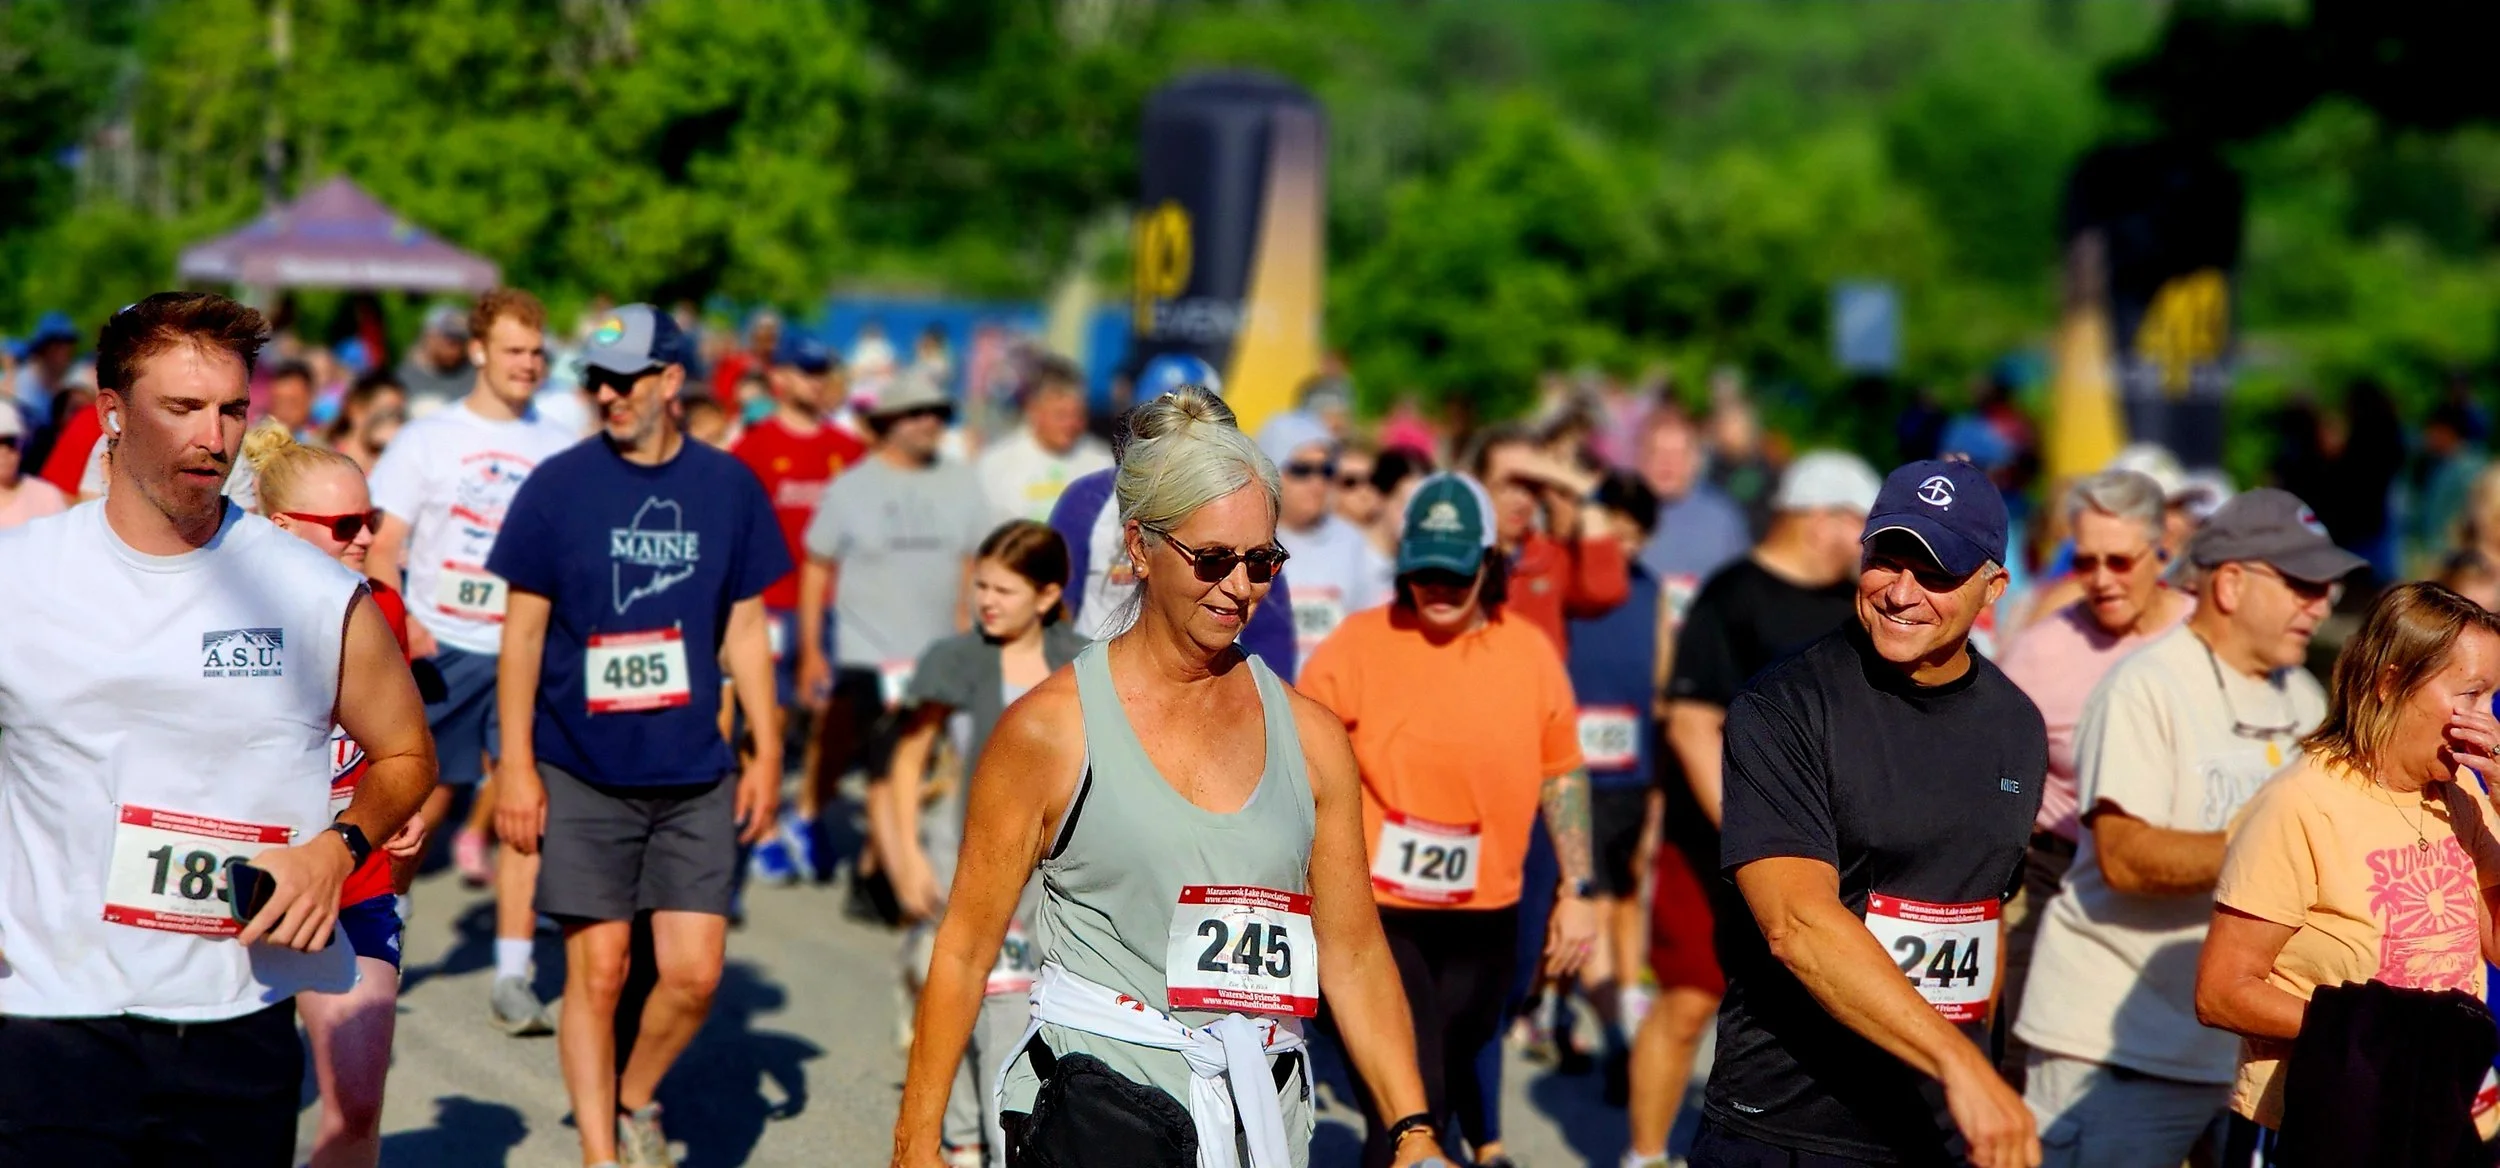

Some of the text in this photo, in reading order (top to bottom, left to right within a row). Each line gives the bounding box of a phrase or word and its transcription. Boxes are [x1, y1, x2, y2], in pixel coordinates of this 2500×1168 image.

[610, 528, 700, 560] MAINE
[458, 579, 493, 606] 87
[204, 647, 281, 667] A.S.U.
[603, 653, 669, 689] 485
[2000, 777, 2020, 794] NIKE
[1400, 838, 1468, 882] 120
[1197, 919, 1291, 979] 245
[1893, 935, 1980, 988] 244
[1218, 989, 1281, 1002] Watershed Friends
